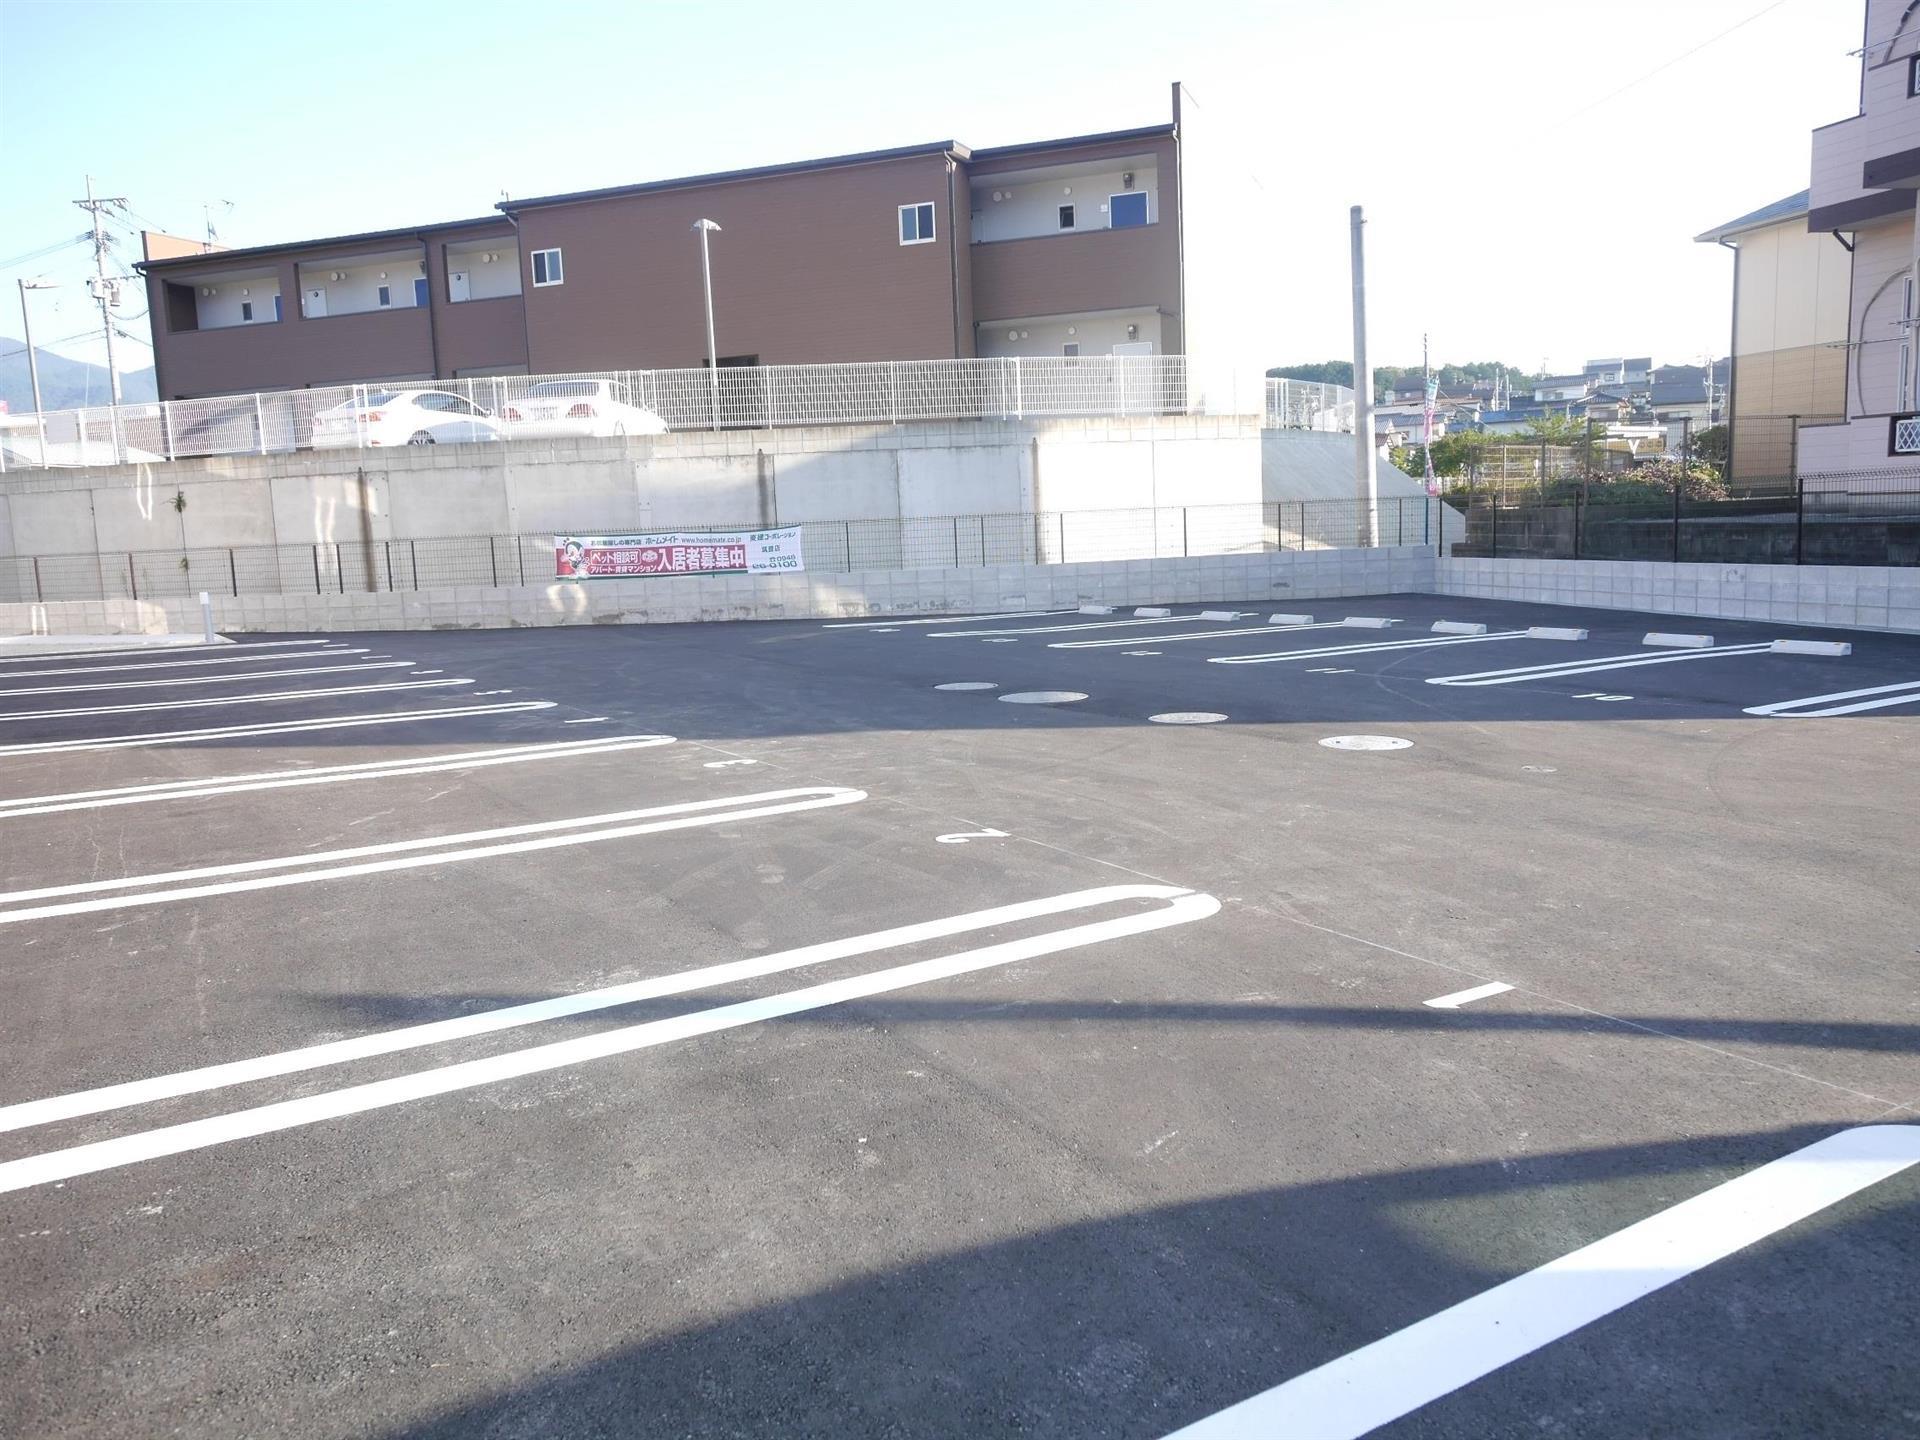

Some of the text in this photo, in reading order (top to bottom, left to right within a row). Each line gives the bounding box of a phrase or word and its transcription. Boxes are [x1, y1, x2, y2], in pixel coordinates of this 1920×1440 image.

[645, 535, 678, 545] ホームメイト
[681, 536, 742, 544] www.homemate.co.jp
[592, 551, 639, 564] ペット相談可
[658, 546, 744, 571] 入居者募集中
[1571, 693, 1635, 701] 10
[935, 827, 1012, 844] 2
